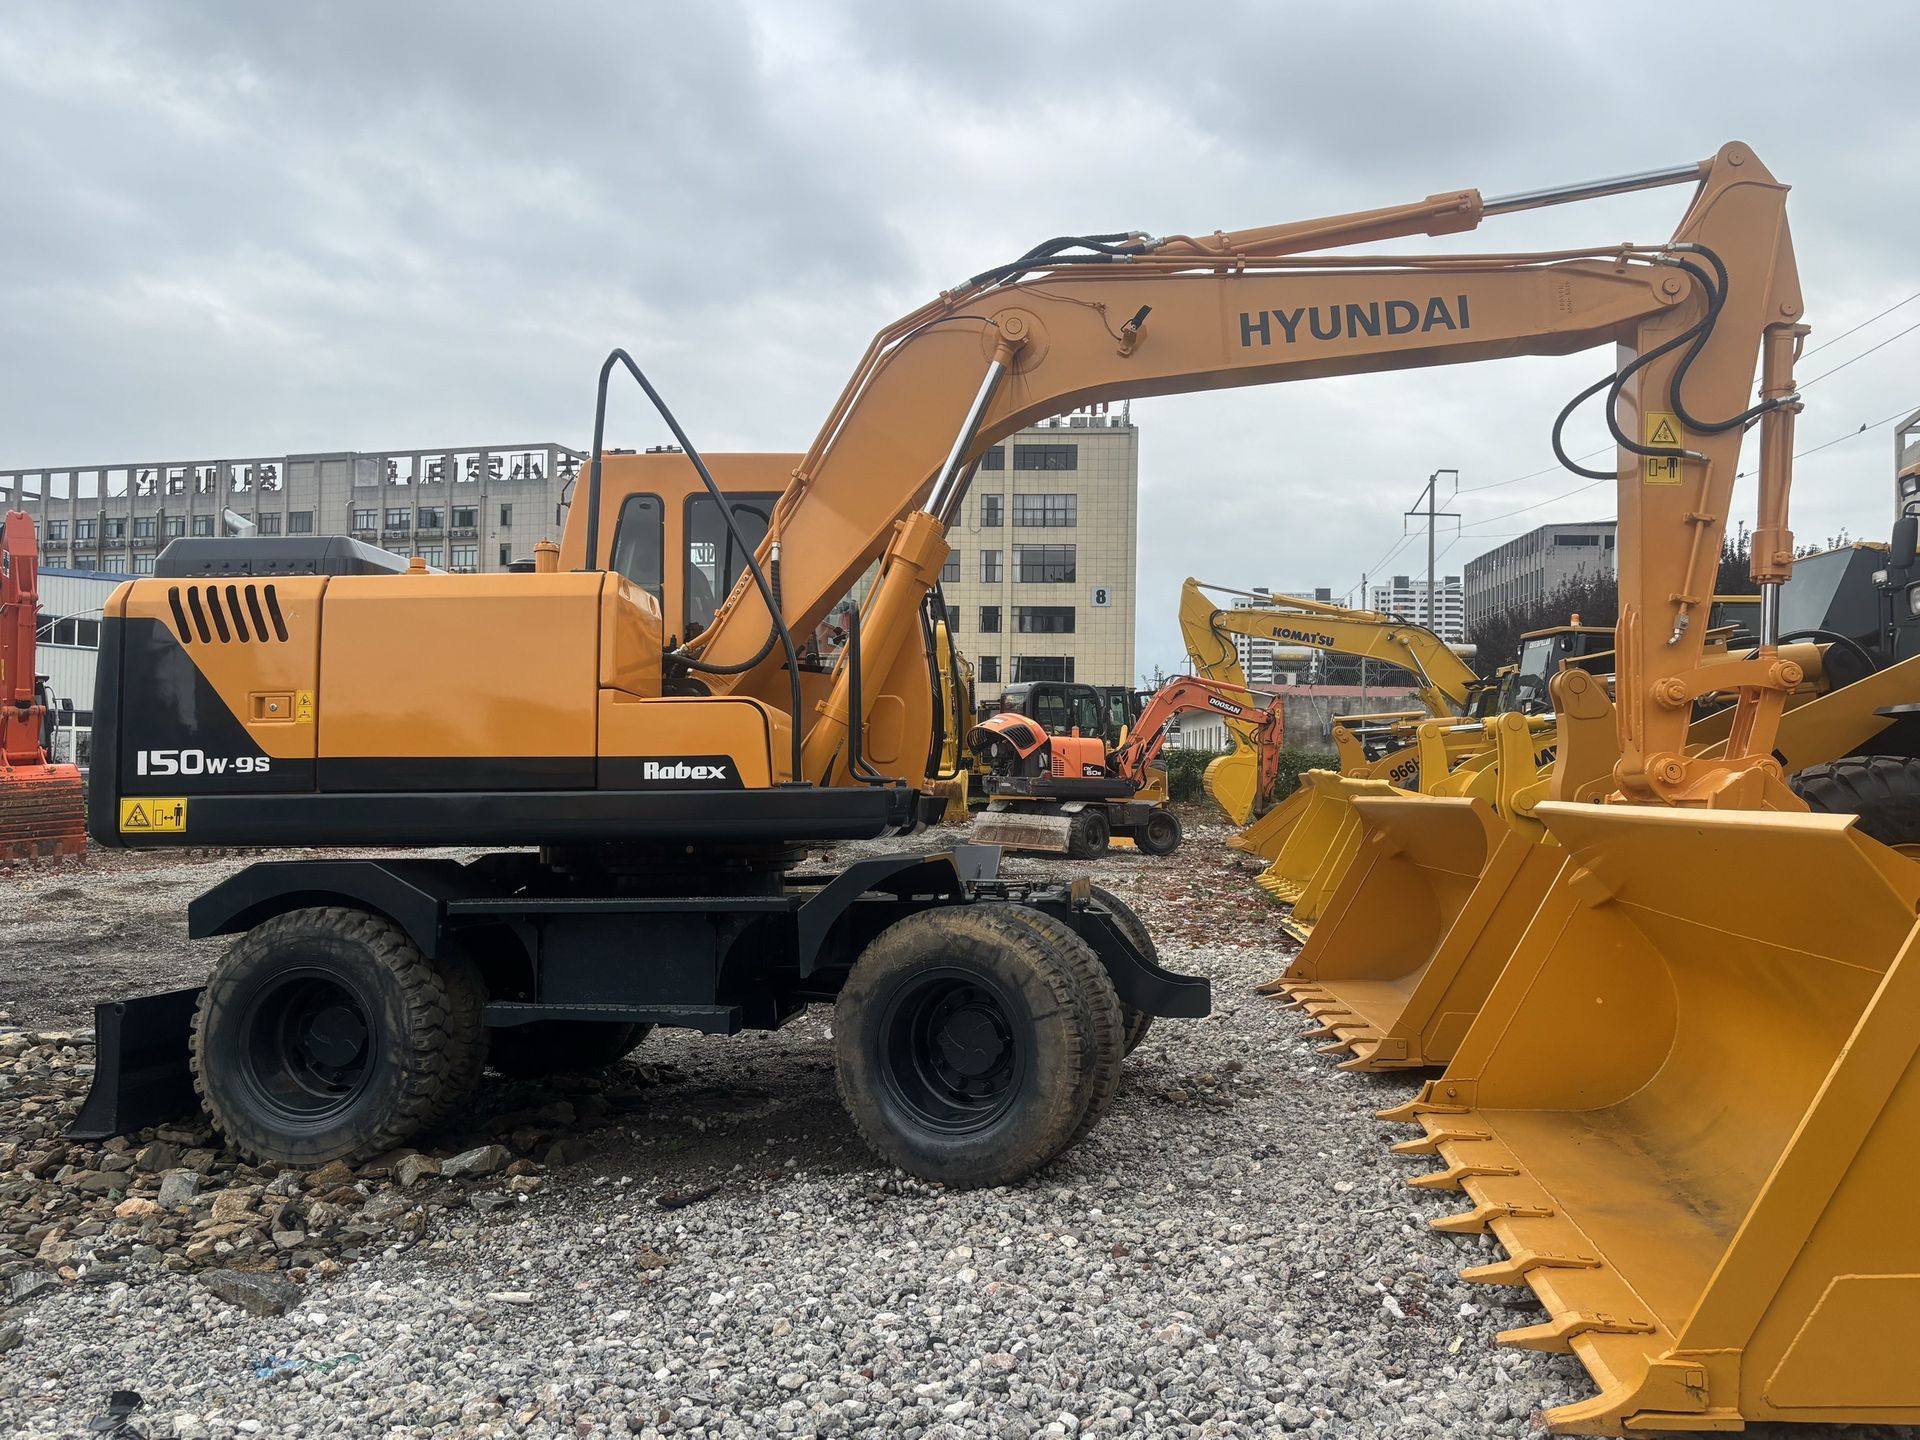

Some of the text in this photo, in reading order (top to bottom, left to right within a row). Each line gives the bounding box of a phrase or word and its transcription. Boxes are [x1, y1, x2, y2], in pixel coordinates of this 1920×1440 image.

[1239, 294, 1470, 347] HYUNDAI
[1095, 588, 1107, 604] 8
[1272, 626, 1335, 647] KOMATSU
[1209, 696, 1241, 715] DOOSAN
[643, 761, 727, 780] Robex
